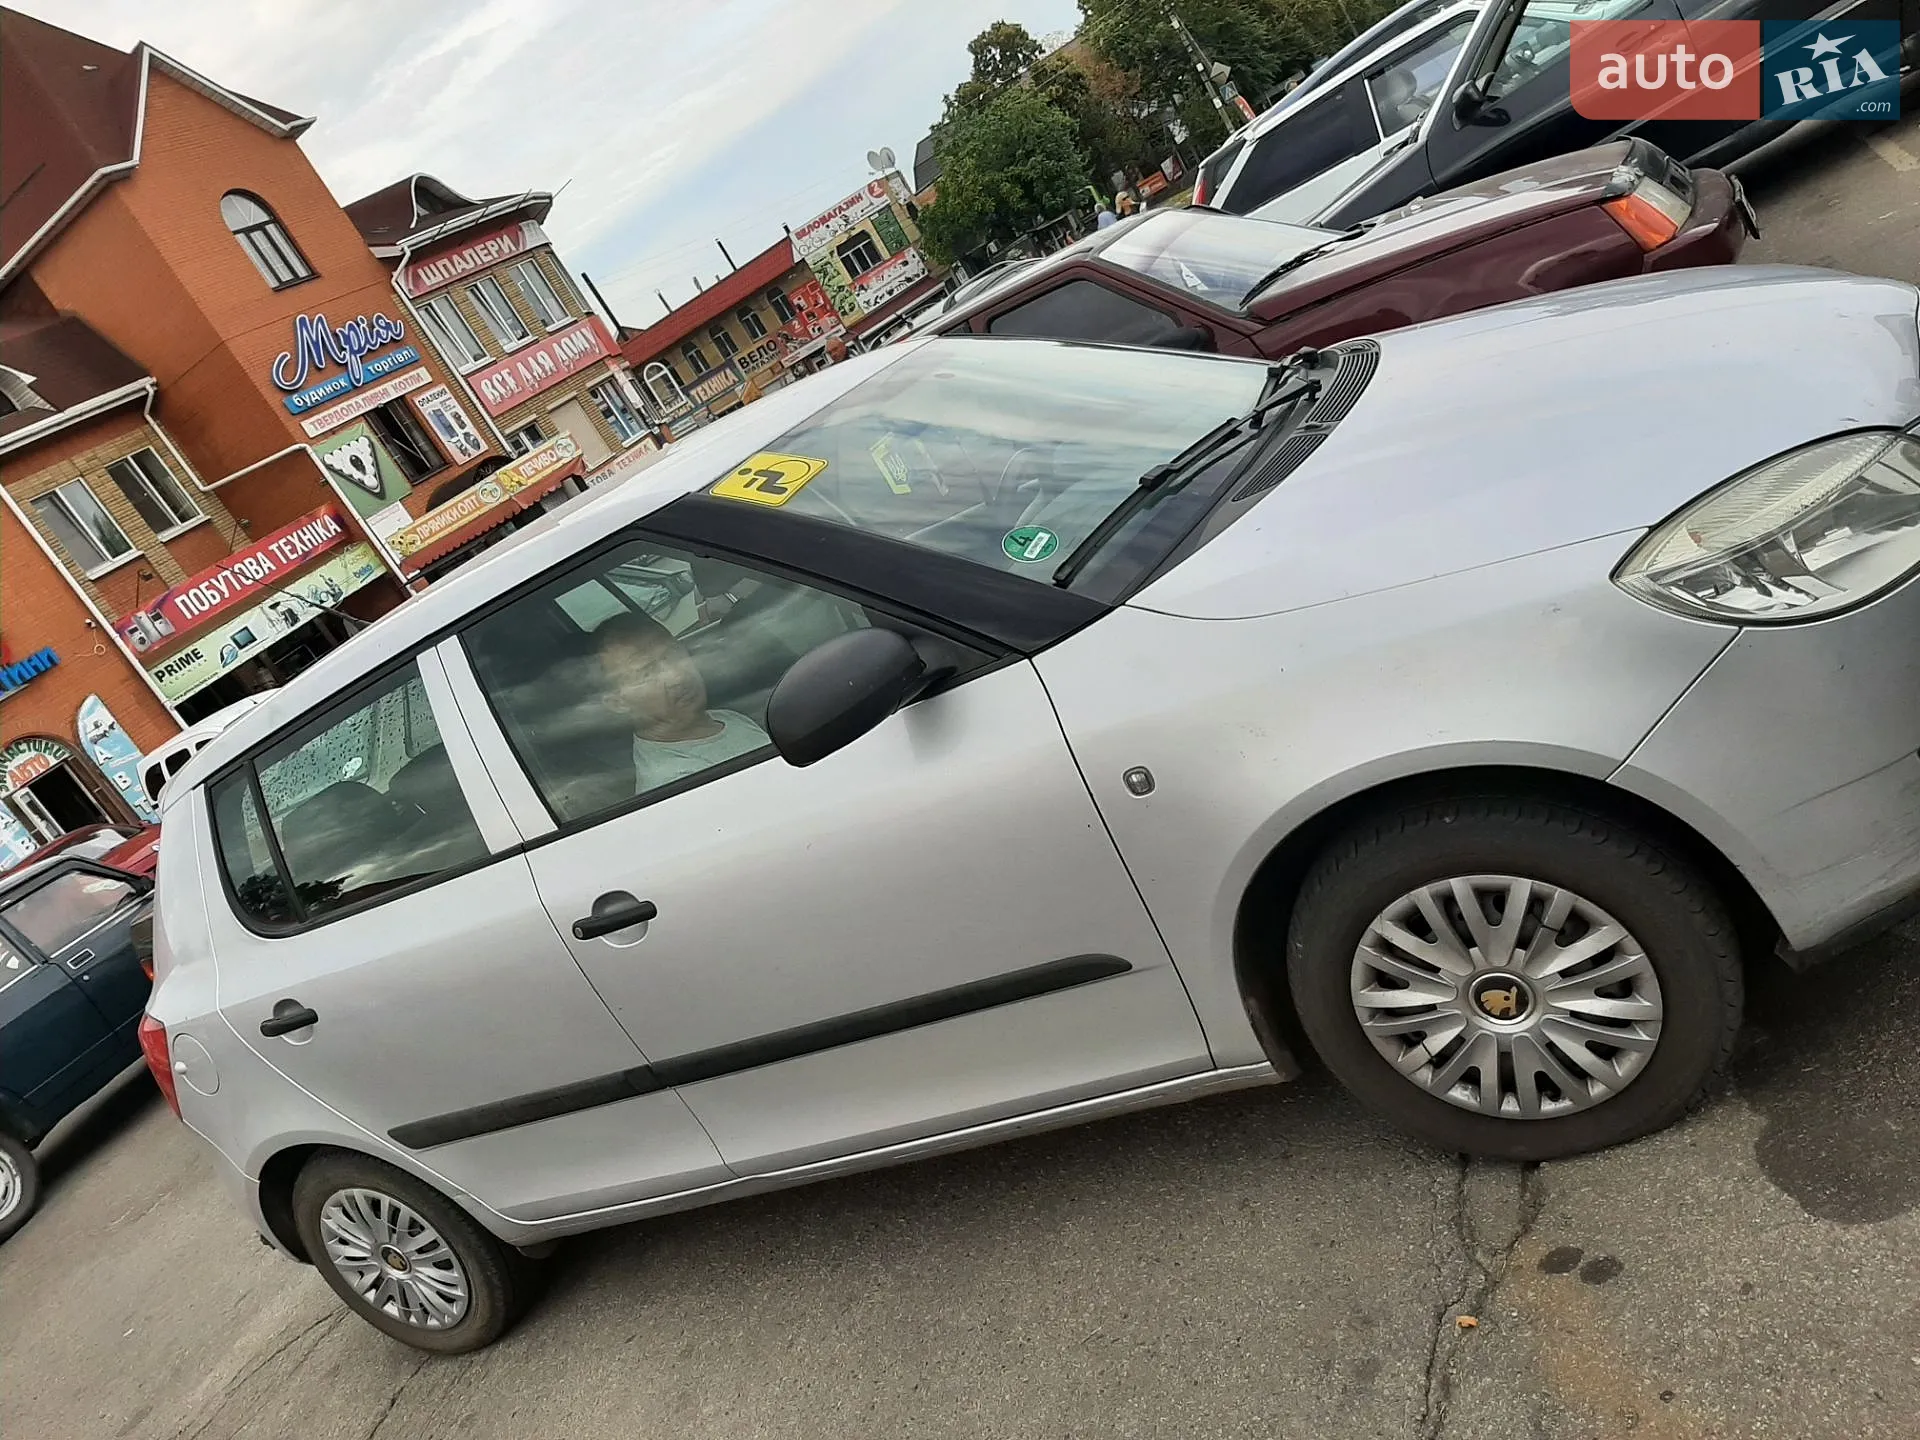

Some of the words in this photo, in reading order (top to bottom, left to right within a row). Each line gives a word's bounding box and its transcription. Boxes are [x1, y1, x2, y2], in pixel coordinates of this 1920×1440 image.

[417, 233, 517, 286] ШПАЛЕРИ
[272, 313, 405, 391] Мрія
[480, 367, 522, 406] ВСЕ
[516, 350, 558, 393] ДЛЯ
[552, 326, 600, 373] ДОМУ
[737, 339, 777, 370] ВЕЛО
[292, 374, 348, 407] будинок
[367, 348, 416, 376] торгівлі
[391, 372, 424, 394] КОТЛИ
[690, 367, 739, 404] ТЕХНІКА
[519, 449, 557, 479] ПЕЧИВО
[416, 504, 460, 540] ПРЯНИКИ
[459, 495, 479, 516] ОПТ
[175, 551, 276, 620] ПОБУТОВА
[268, 514, 342, 565] ТЕХНІКА
[8, 753, 51, 789] АВТО
